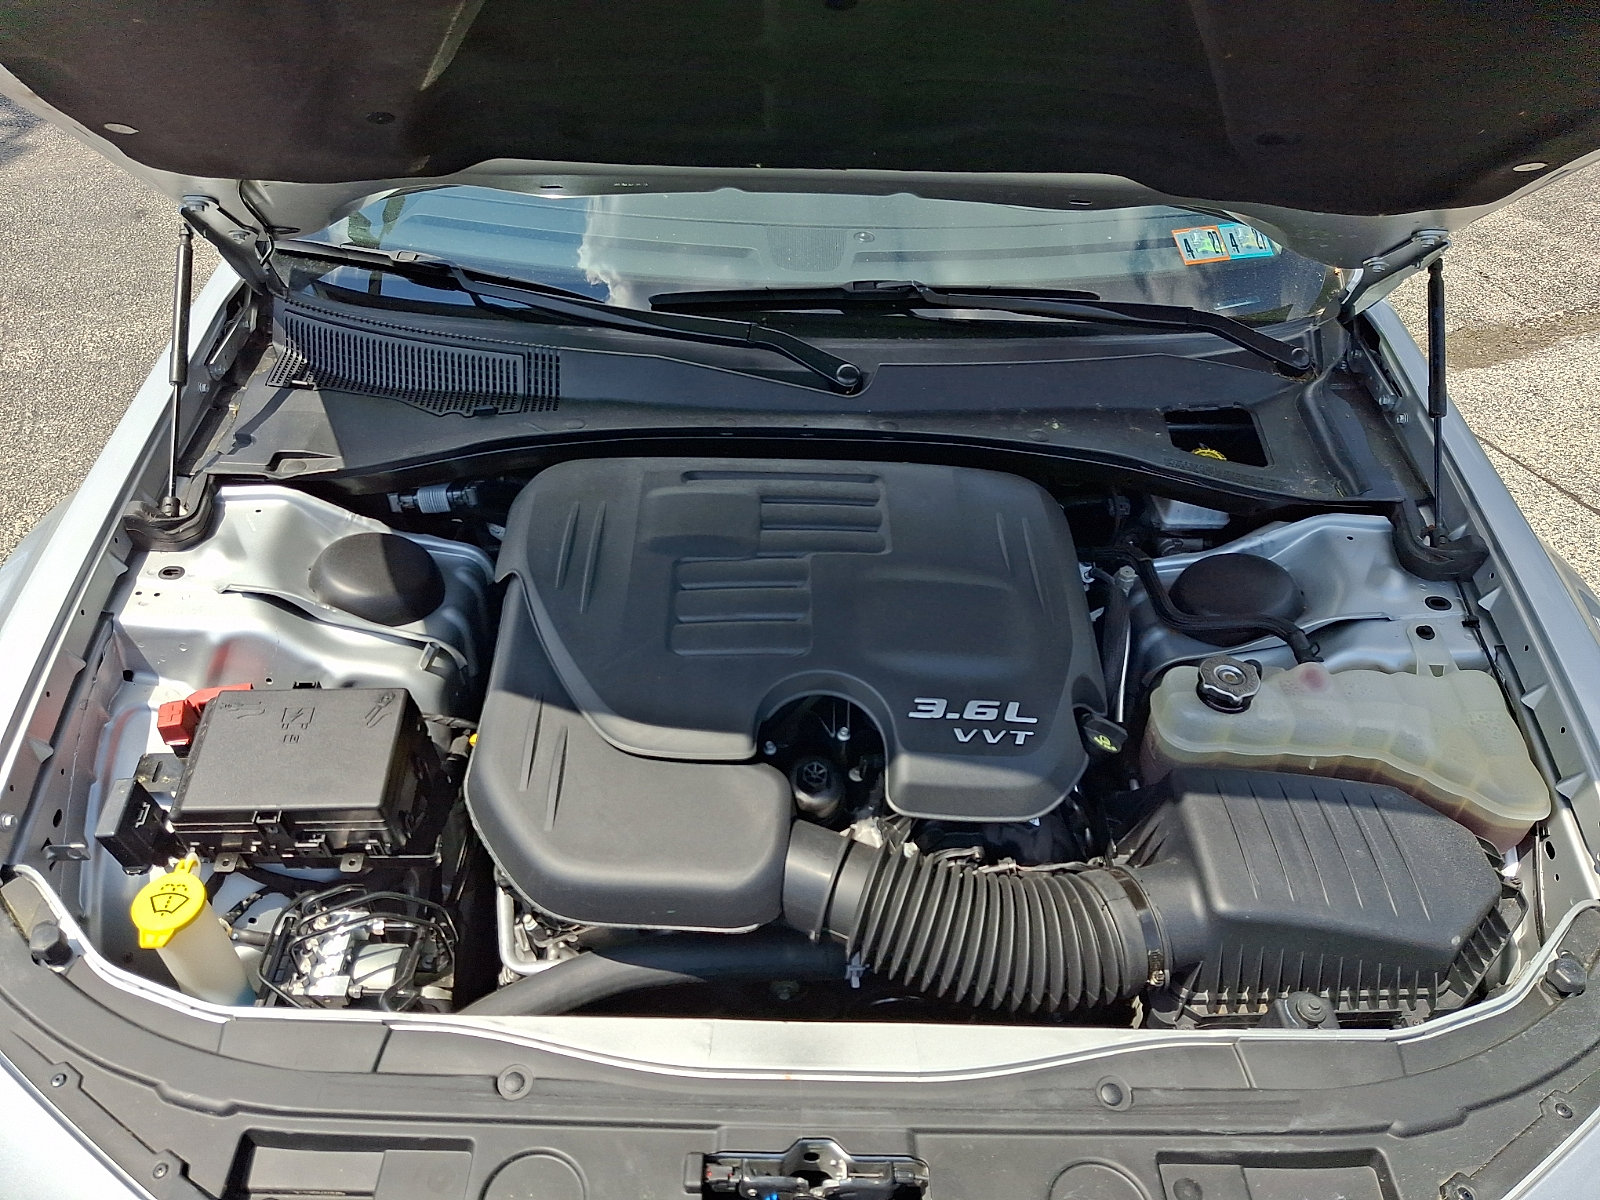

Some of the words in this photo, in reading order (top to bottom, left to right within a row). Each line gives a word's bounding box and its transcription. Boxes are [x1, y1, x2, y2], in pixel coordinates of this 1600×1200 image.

[1183, 238, 1196, 259] 4
[1228, 232, 1240, 254] 4
[908, 697, 1038, 724] 3.6L
[953, 728, 1034, 745] VVT
